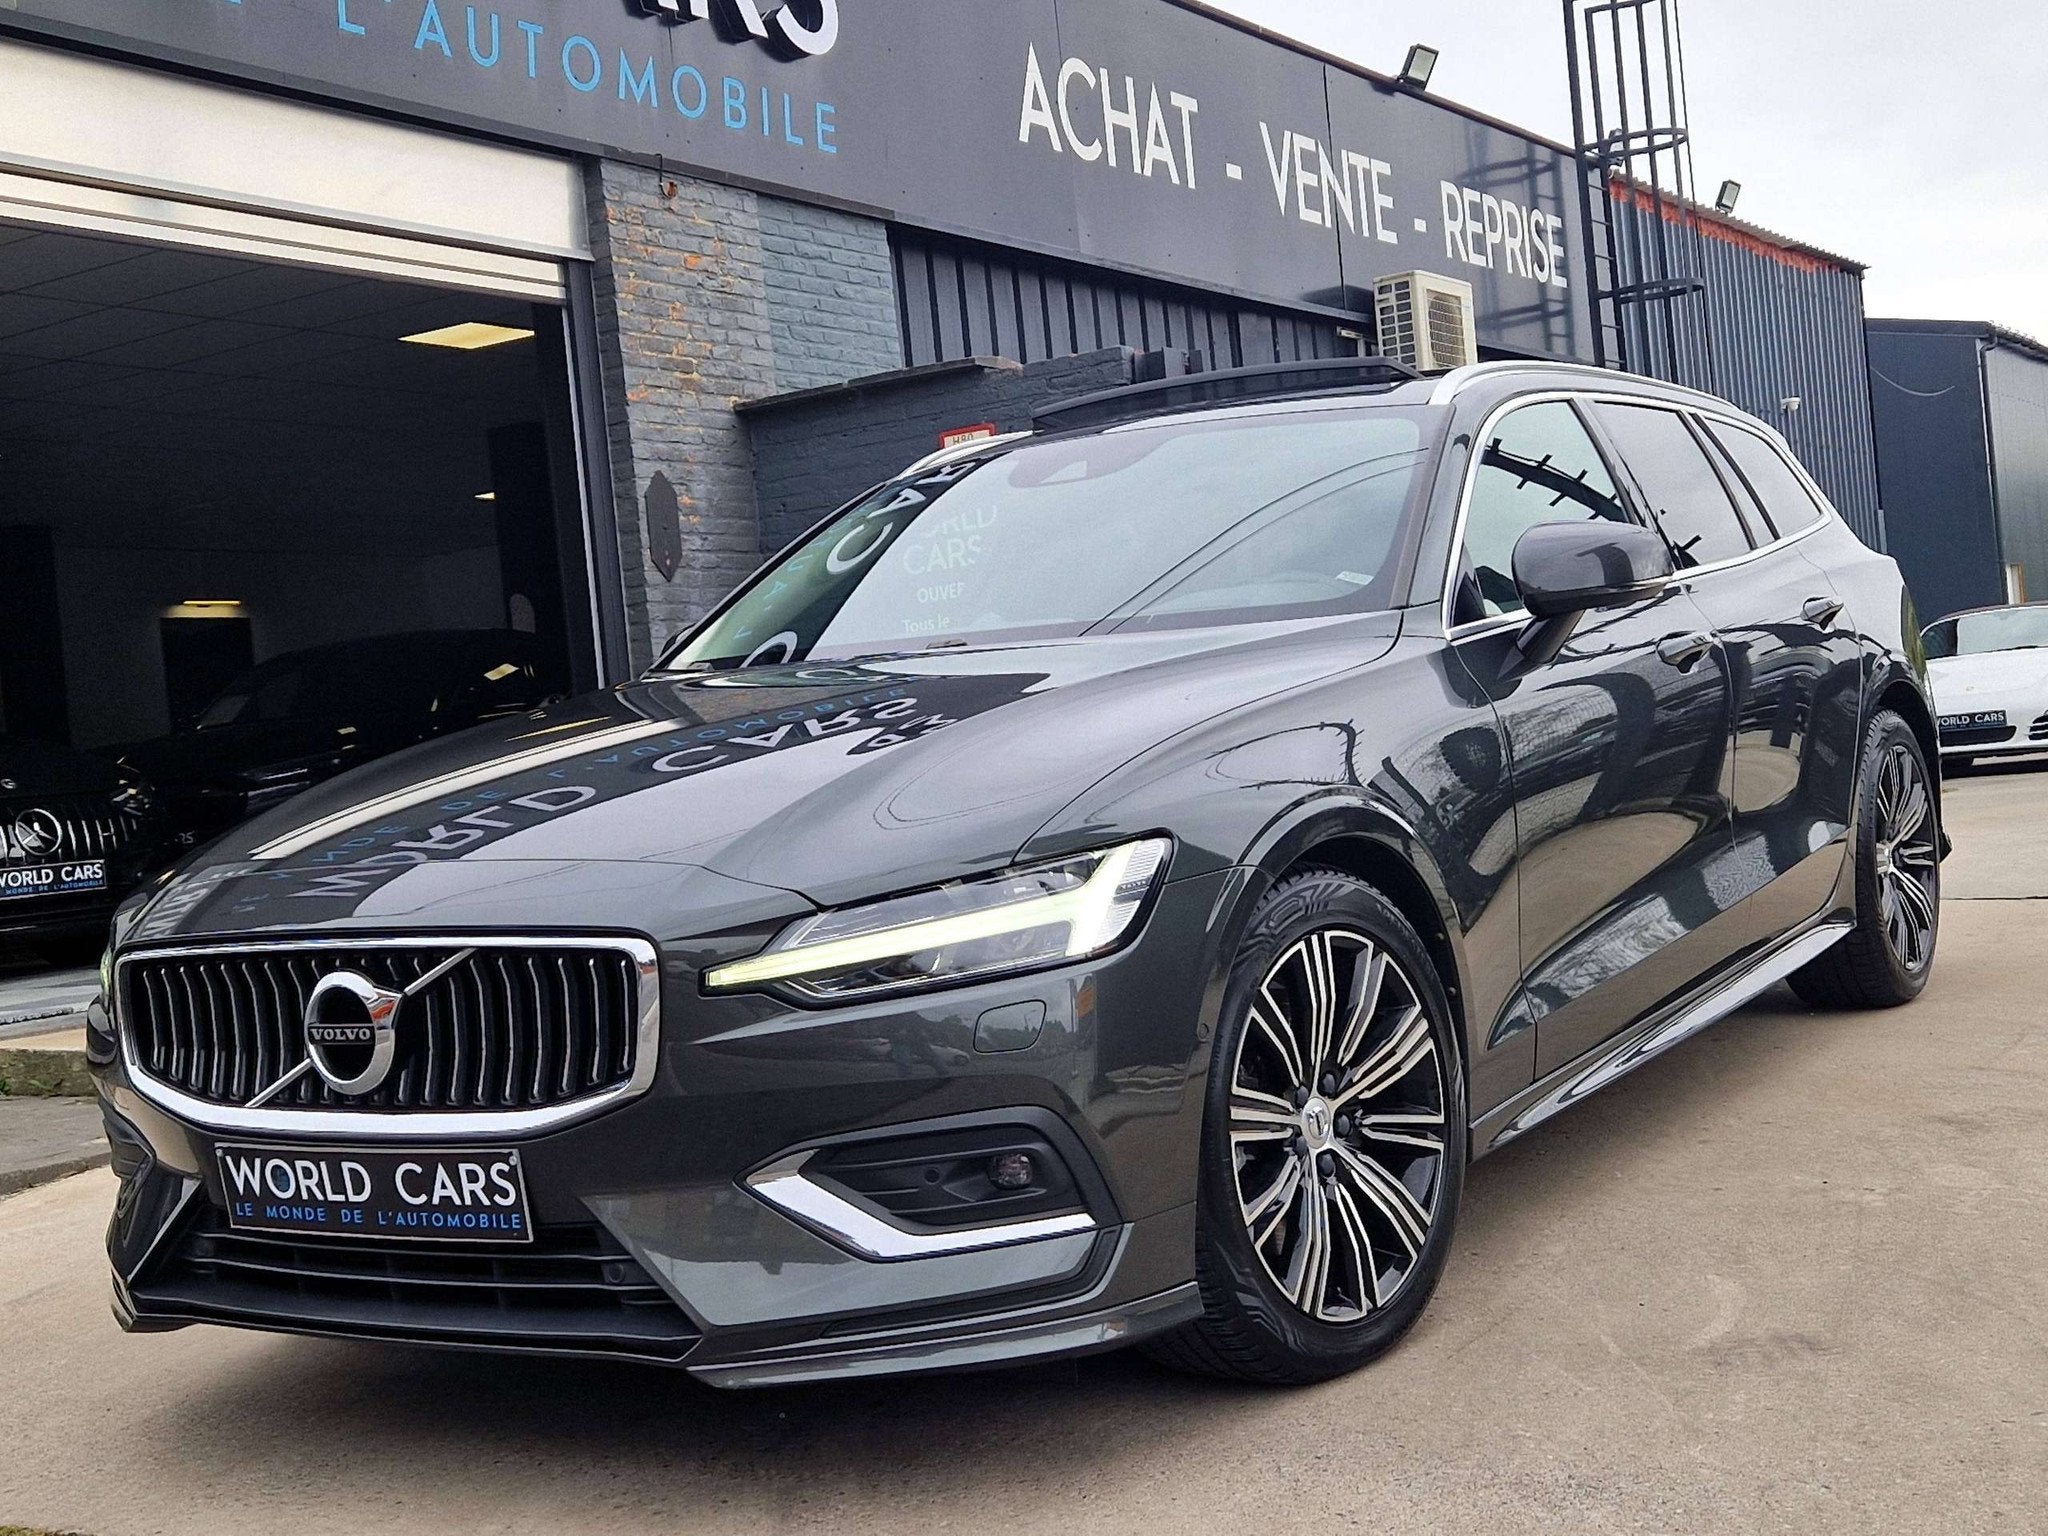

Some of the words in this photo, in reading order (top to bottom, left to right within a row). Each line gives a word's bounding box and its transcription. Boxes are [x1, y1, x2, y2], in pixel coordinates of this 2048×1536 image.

[338, 0, 838, 153] LAUTOMOBILE
[1019, 42, 1199, 189] ACHAT
[1259, 122, 1398, 244] VENTE
[1440, 180, 1569, 289] REPRISE
[1974, 712, 2004, 723] CARS
[61, 863, 103, 882] CARS
[310, 1028, 371, 1040] VOLVO
[225, 1155, 372, 1203] WORLD
[395, 1162, 517, 1206] CARS
[236, 1203, 253, 1217] LE
[266, 1205, 326, 1221] MONDE
[341, 1209, 363, 1223] DE
[378, 1210, 521, 1229] L'AUTOMOBILE
